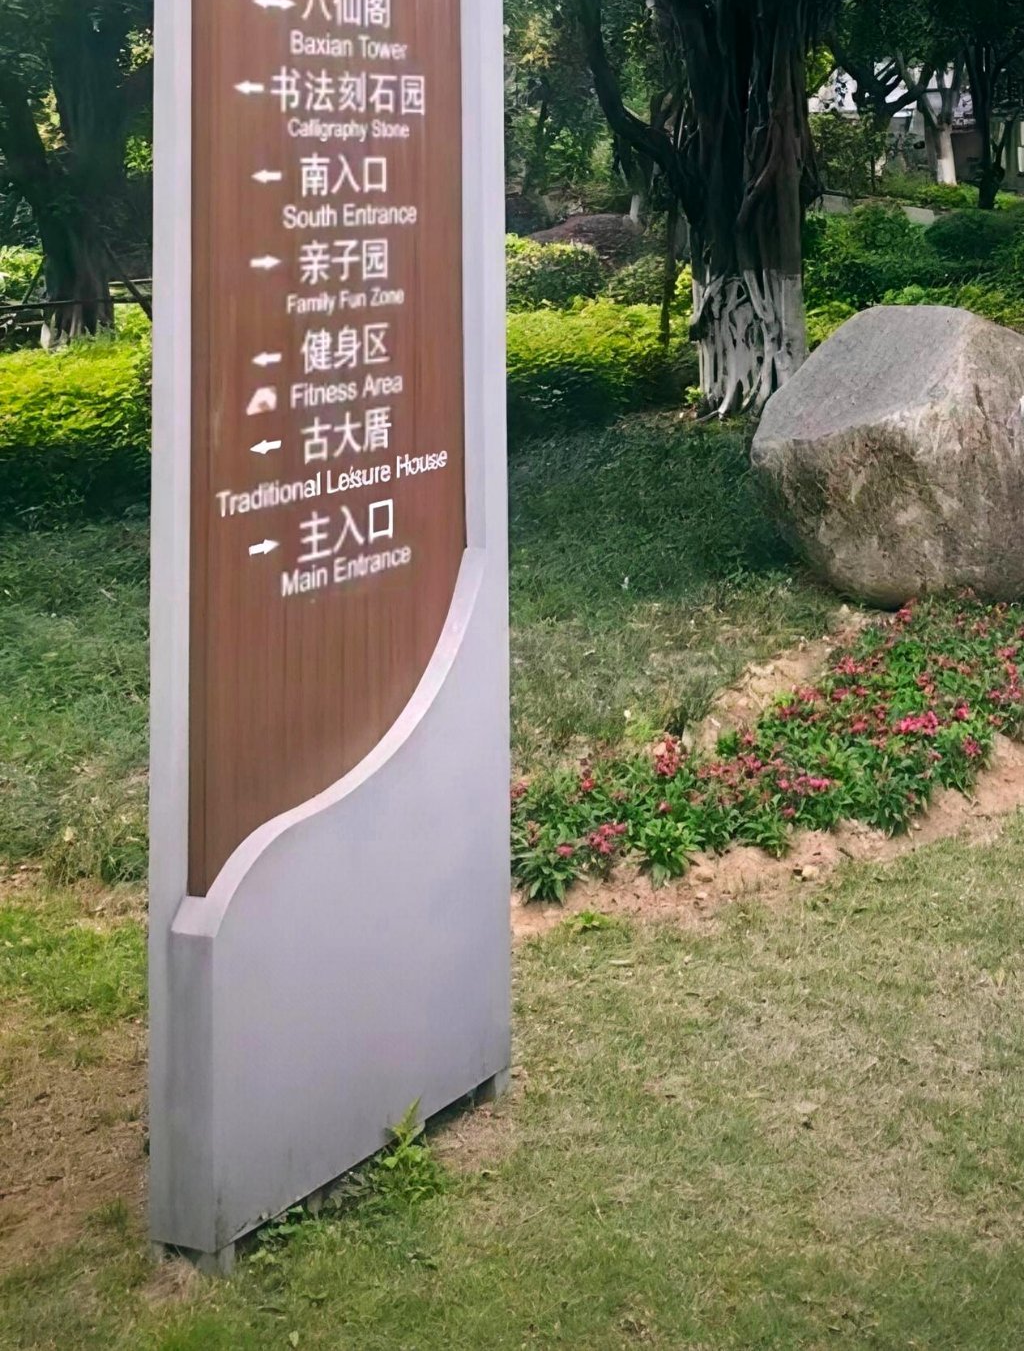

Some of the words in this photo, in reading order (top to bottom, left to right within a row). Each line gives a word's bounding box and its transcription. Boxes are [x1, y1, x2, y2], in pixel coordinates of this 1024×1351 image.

[290, 29, 352, 58] Baxian
[358, 35, 407, 60] Tower
[270, 65, 425, 115] 书法刻石园
[300, 153, 387, 197] 南入口
[283, 205, 338, 230] South
[343, 203, 417, 226] Entrance
[299, 238, 389, 285] 亲子园
[287, 292, 336, 315] Family
[340, 290, 367, 308] Fun
[370, 287, 405, 306] Zone
[301, 322, 391, 374] 健身区
[290, 380, 357, 409] Fitness
[362, 374, 403, 399] Area
[216, 472, 322, 518] Traditional
[396, 450, 448, 478] House
[297, 499, 394, 564] 主入口
[281, 565, 328, 598] Main
[333, 544, 411, 584] Entrance
